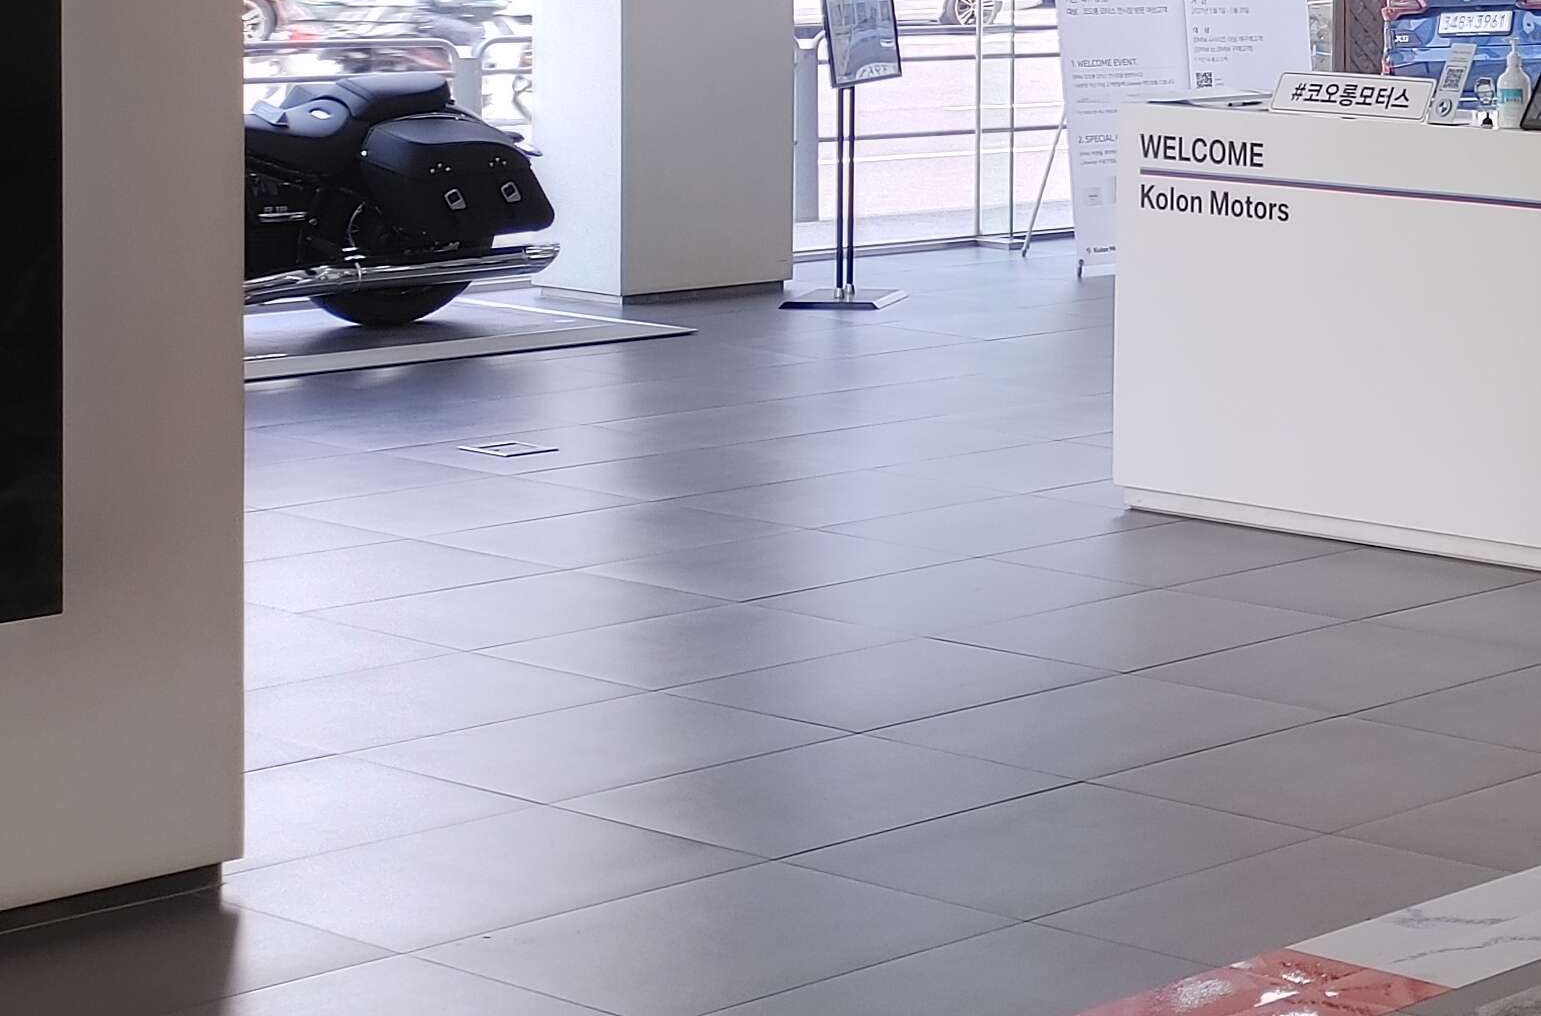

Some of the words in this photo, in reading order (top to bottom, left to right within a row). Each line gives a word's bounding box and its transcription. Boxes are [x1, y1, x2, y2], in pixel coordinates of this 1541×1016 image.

[1291, 82, 1410, 110] #코오롱모터스
[1139, 133, 1264, 168] WELCOME
[1140, 183, 1203, 215] Kolon
[1209, 190, 1290, 222] Motors
